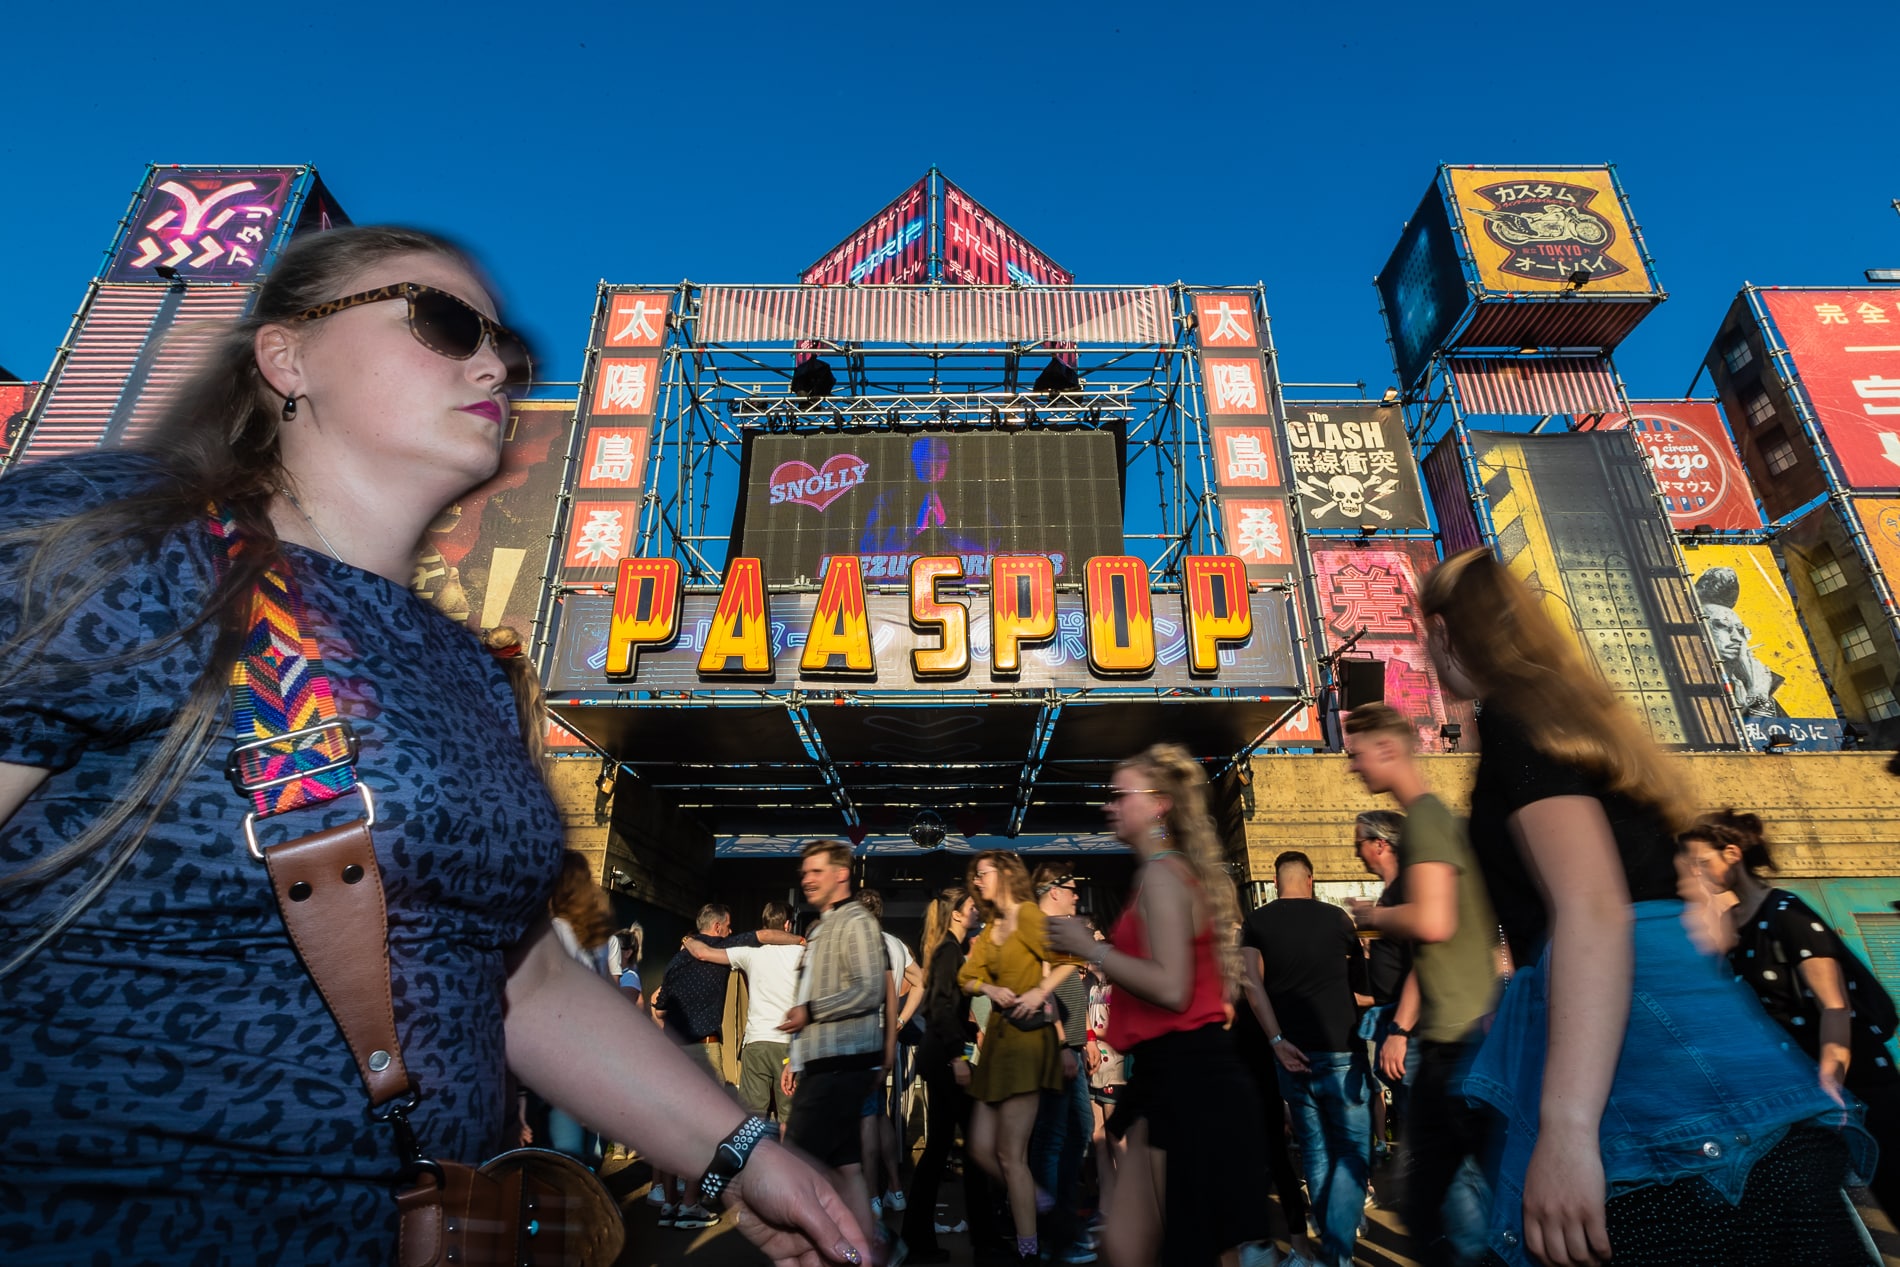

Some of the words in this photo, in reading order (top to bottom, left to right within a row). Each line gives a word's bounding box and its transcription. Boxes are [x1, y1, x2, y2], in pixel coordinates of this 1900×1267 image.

[1495, 183, 1577, 203] カスタム
[227, 206, 273, 267] アタリ
[1536, 244, 1583, 257] TOKYO
[1814, 302, 1900, 325] 完全
[1307, 411, 1329, 423] The
[1287, 421, 1386, 450] CLASH
[1643, 433, 1675, 443] うこそ
[1662, 443, 1700, 453] circus
[1291, 449, 1399, 475] 無線衝突
[1648, 445, 1709, 479] kyo
[769, 462, 870, 505] SNOLLY
[1659, 480, 1716, 493] ドマウス
[604, 555, 1252, 678] PAASPOP
[1737, 722, 1830, 742] 私の心に
